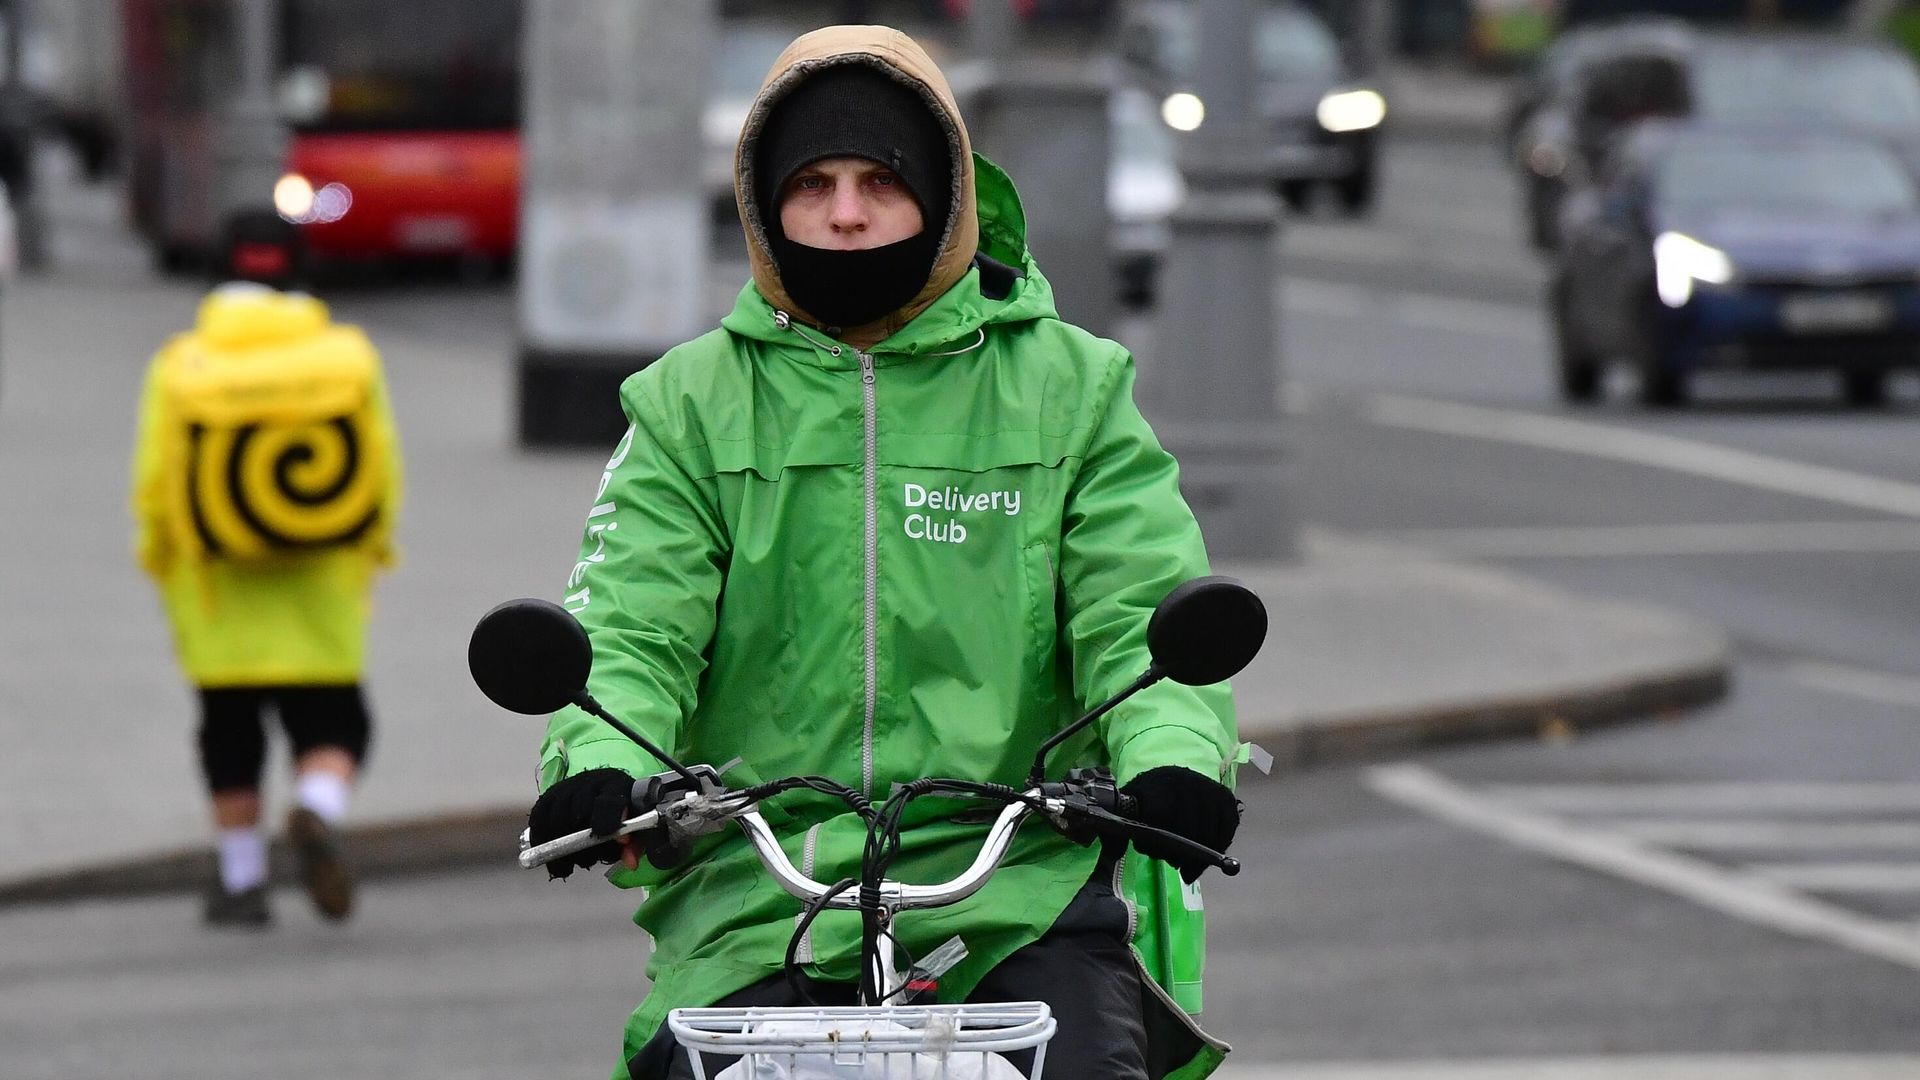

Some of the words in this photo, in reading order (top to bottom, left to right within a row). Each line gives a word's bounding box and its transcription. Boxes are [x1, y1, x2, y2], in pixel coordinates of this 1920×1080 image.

[904, 483, 1021, 516] Delivery
[564, 423, 637, 614] Dliver
[904, 513, 967, 544] Club
